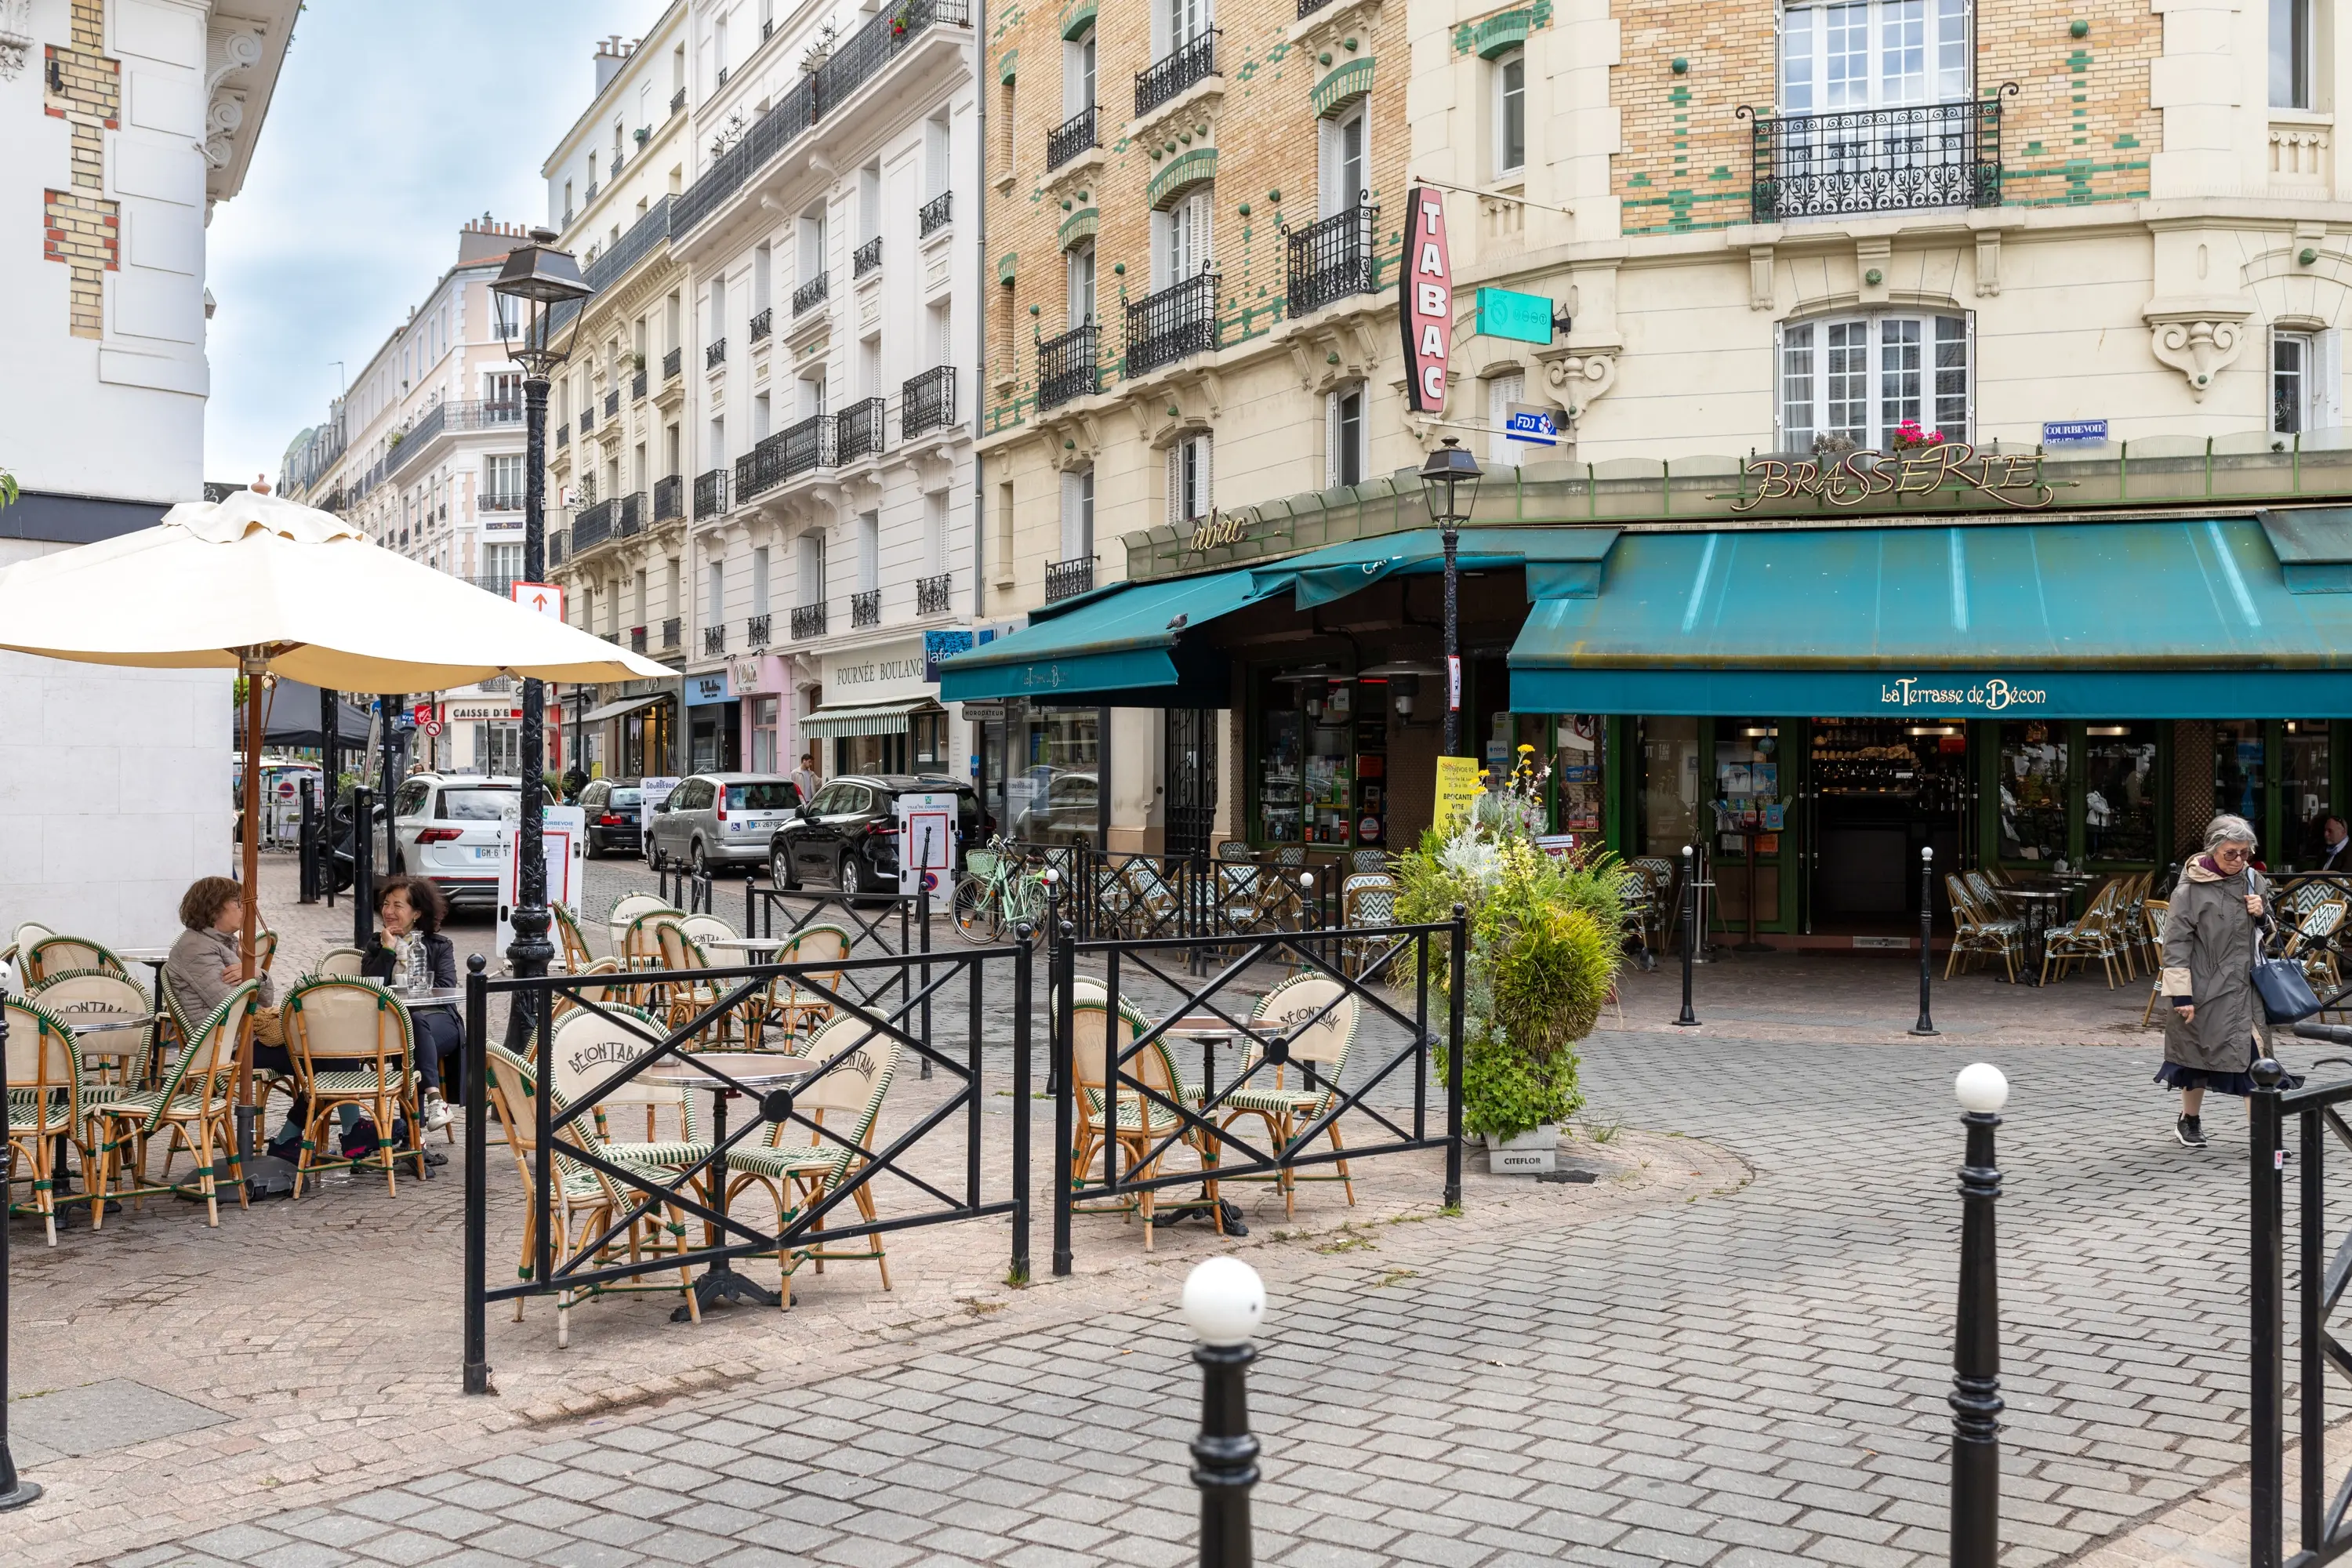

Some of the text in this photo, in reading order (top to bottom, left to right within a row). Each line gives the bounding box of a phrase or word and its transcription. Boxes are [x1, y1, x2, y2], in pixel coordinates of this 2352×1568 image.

[1417, 200, 1447, 399] TABAC
[1516, 416, 1536, 430] FDJ
[2045, 424, 2105, 435] COURBEVOIE
[1730, 442, 2054, 512] BRASSERIE
[837, 658, 923, 685] FOURNÉE BOULANG
[1882, 677, 2046, 710] La Terrasse de Bécon
[453, 709, 488, 717] CAISSE
[568, 1042, 644, 1073] BECONTABA
